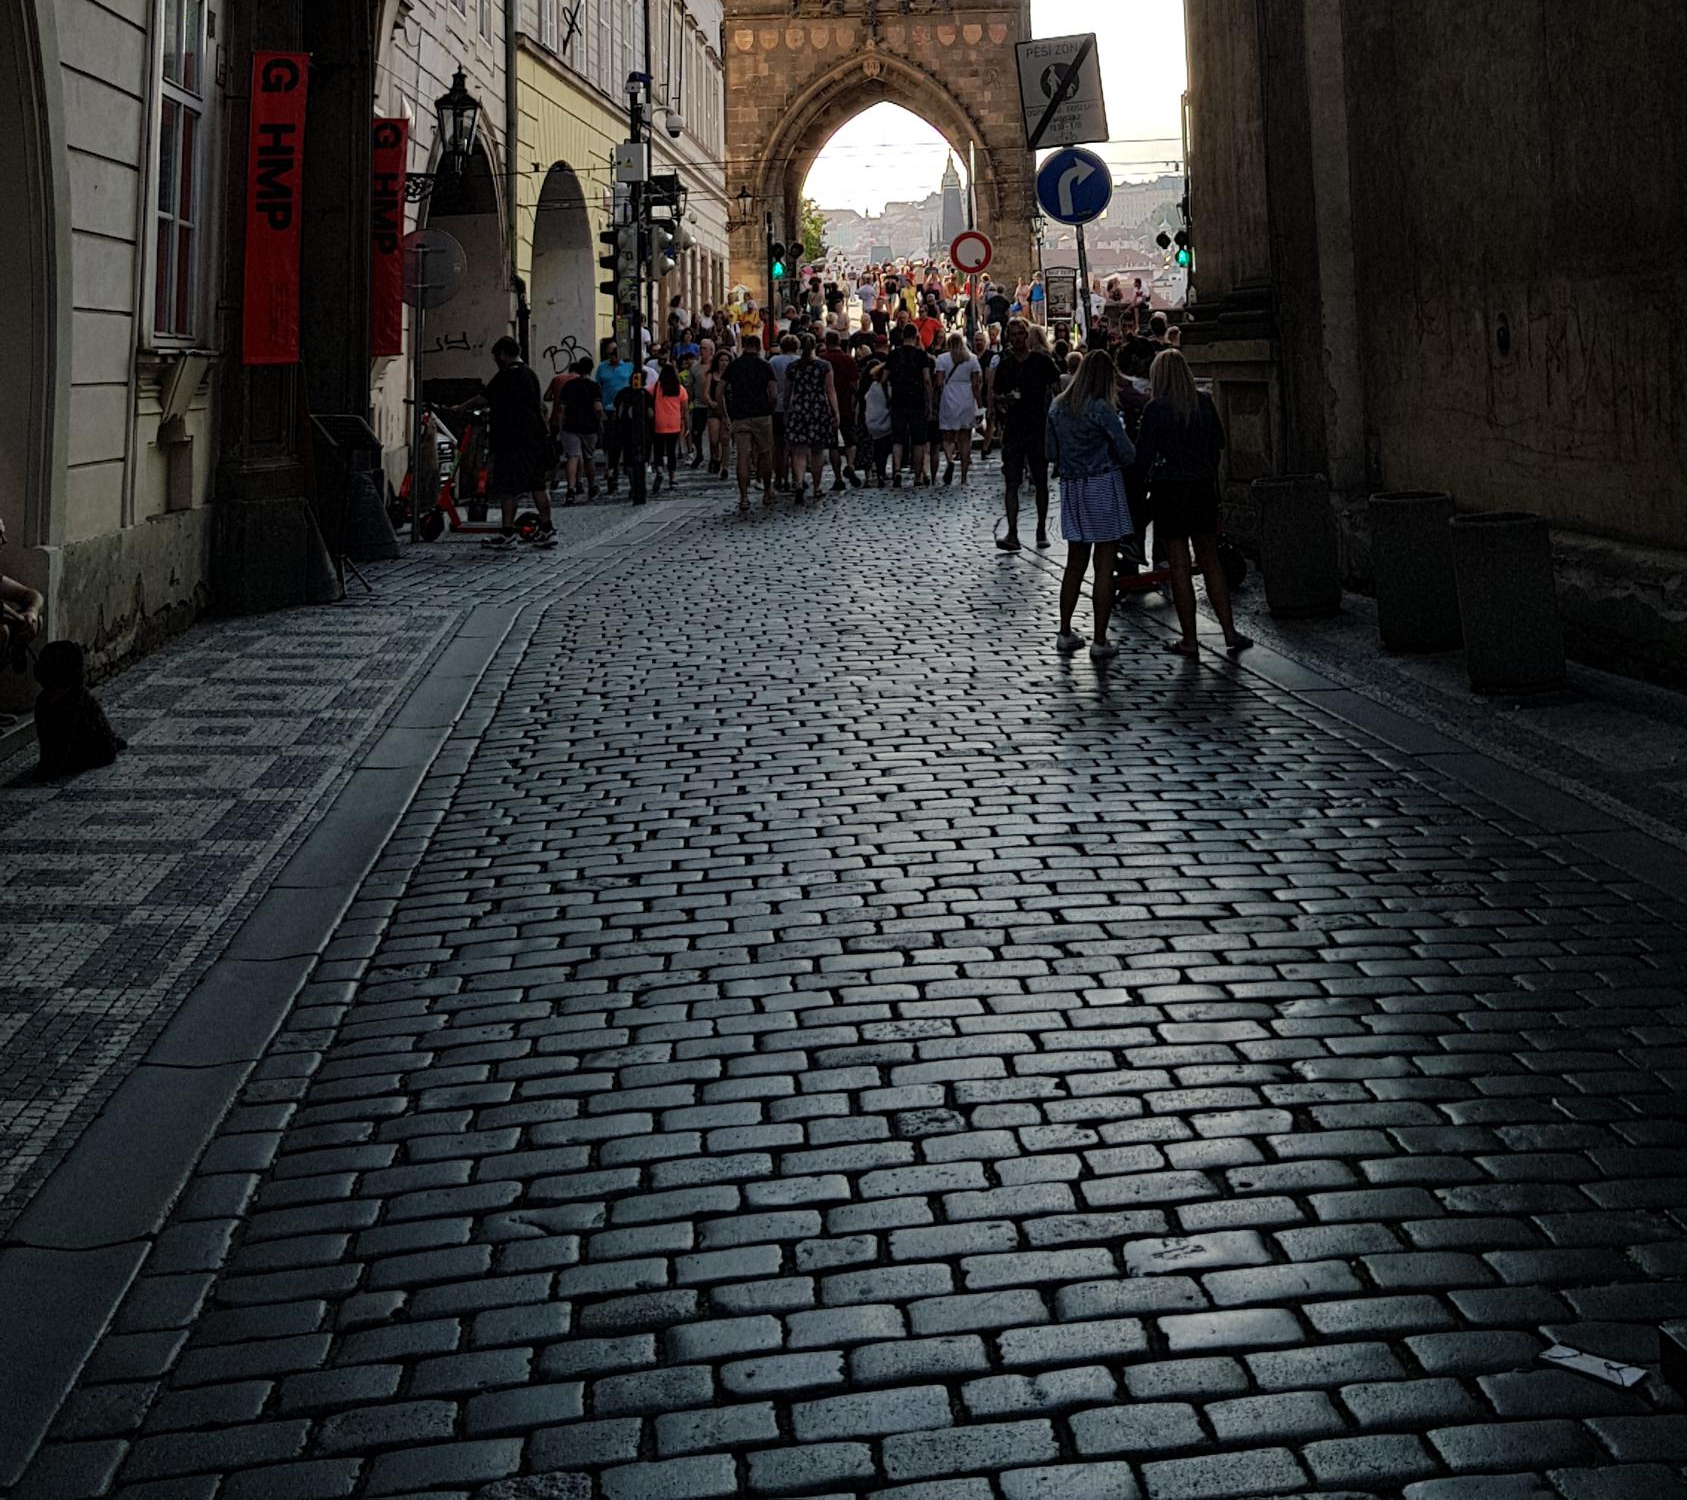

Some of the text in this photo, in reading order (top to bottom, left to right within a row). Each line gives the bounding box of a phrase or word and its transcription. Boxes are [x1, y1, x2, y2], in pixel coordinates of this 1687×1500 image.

[1055, 40, 1083, 55] ZÓN
[255, 58, 300, 231] G HMP
[370, 173, 400, 254] HMP
